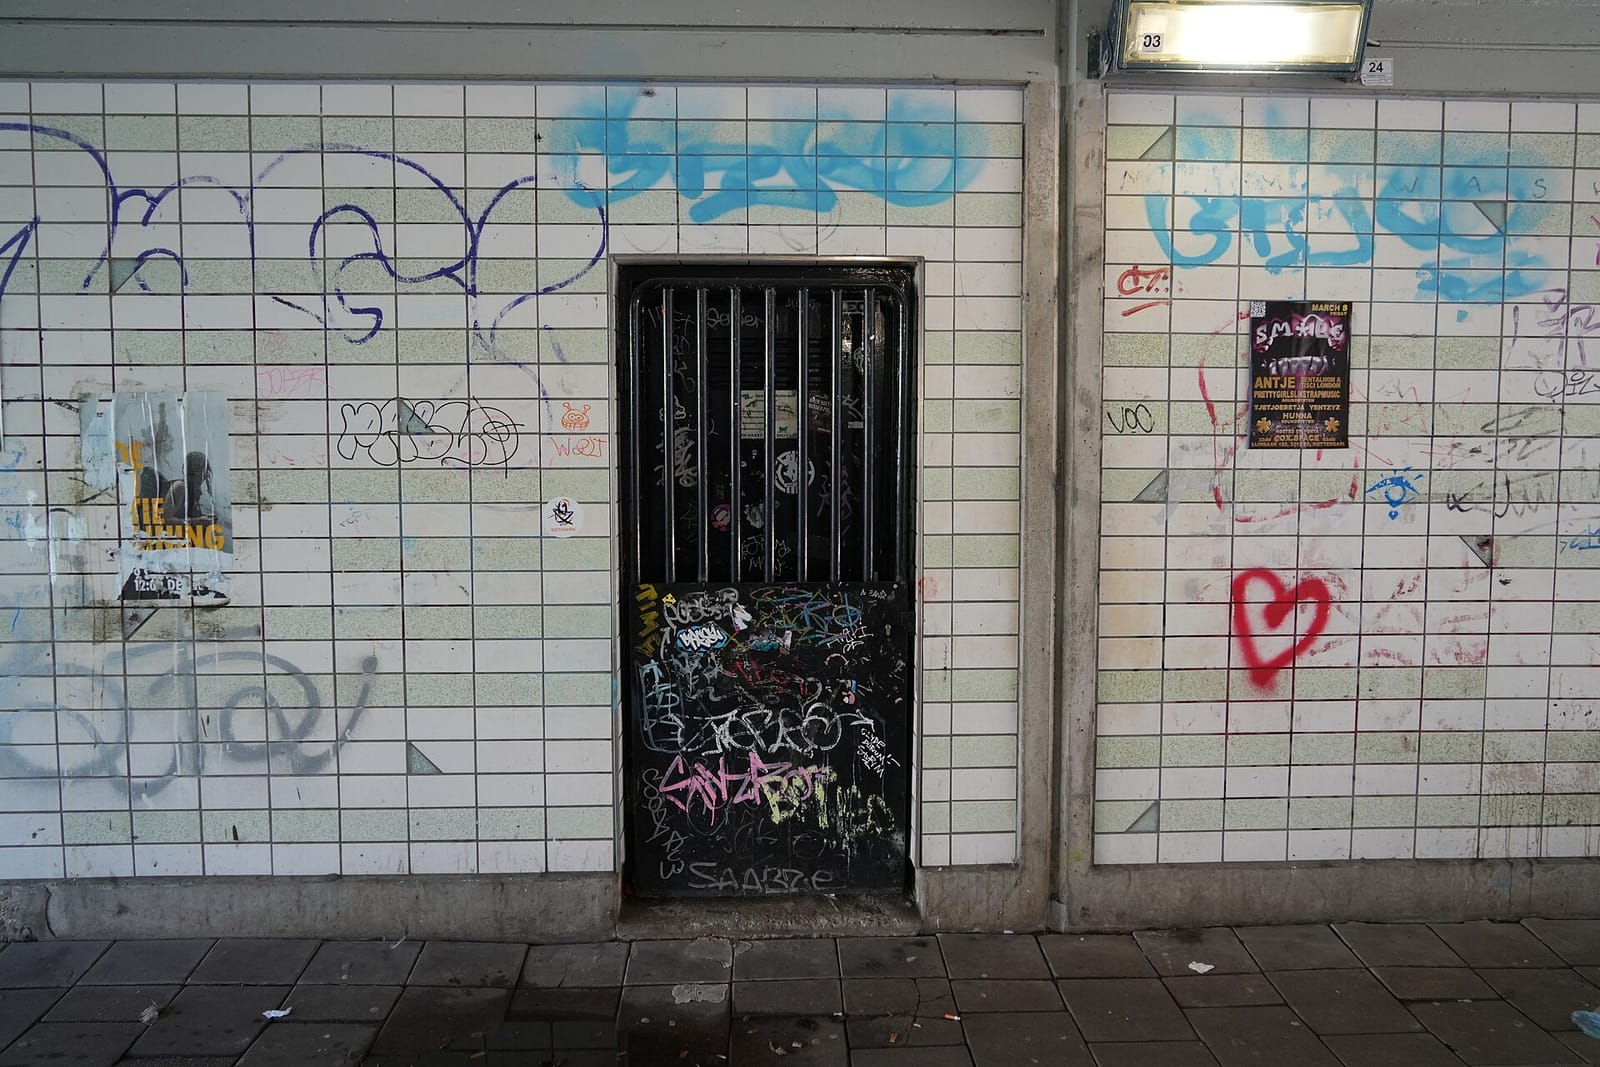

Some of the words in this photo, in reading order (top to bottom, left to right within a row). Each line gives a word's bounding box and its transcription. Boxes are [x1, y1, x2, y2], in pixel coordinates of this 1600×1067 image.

[1368, 61, 1384, 73] 24
[1311, 304, 1341, 312] MARCH
[1254, 376, 1296, 389] ANTJE
[1282, 412, 1313, 420] HUNNA
